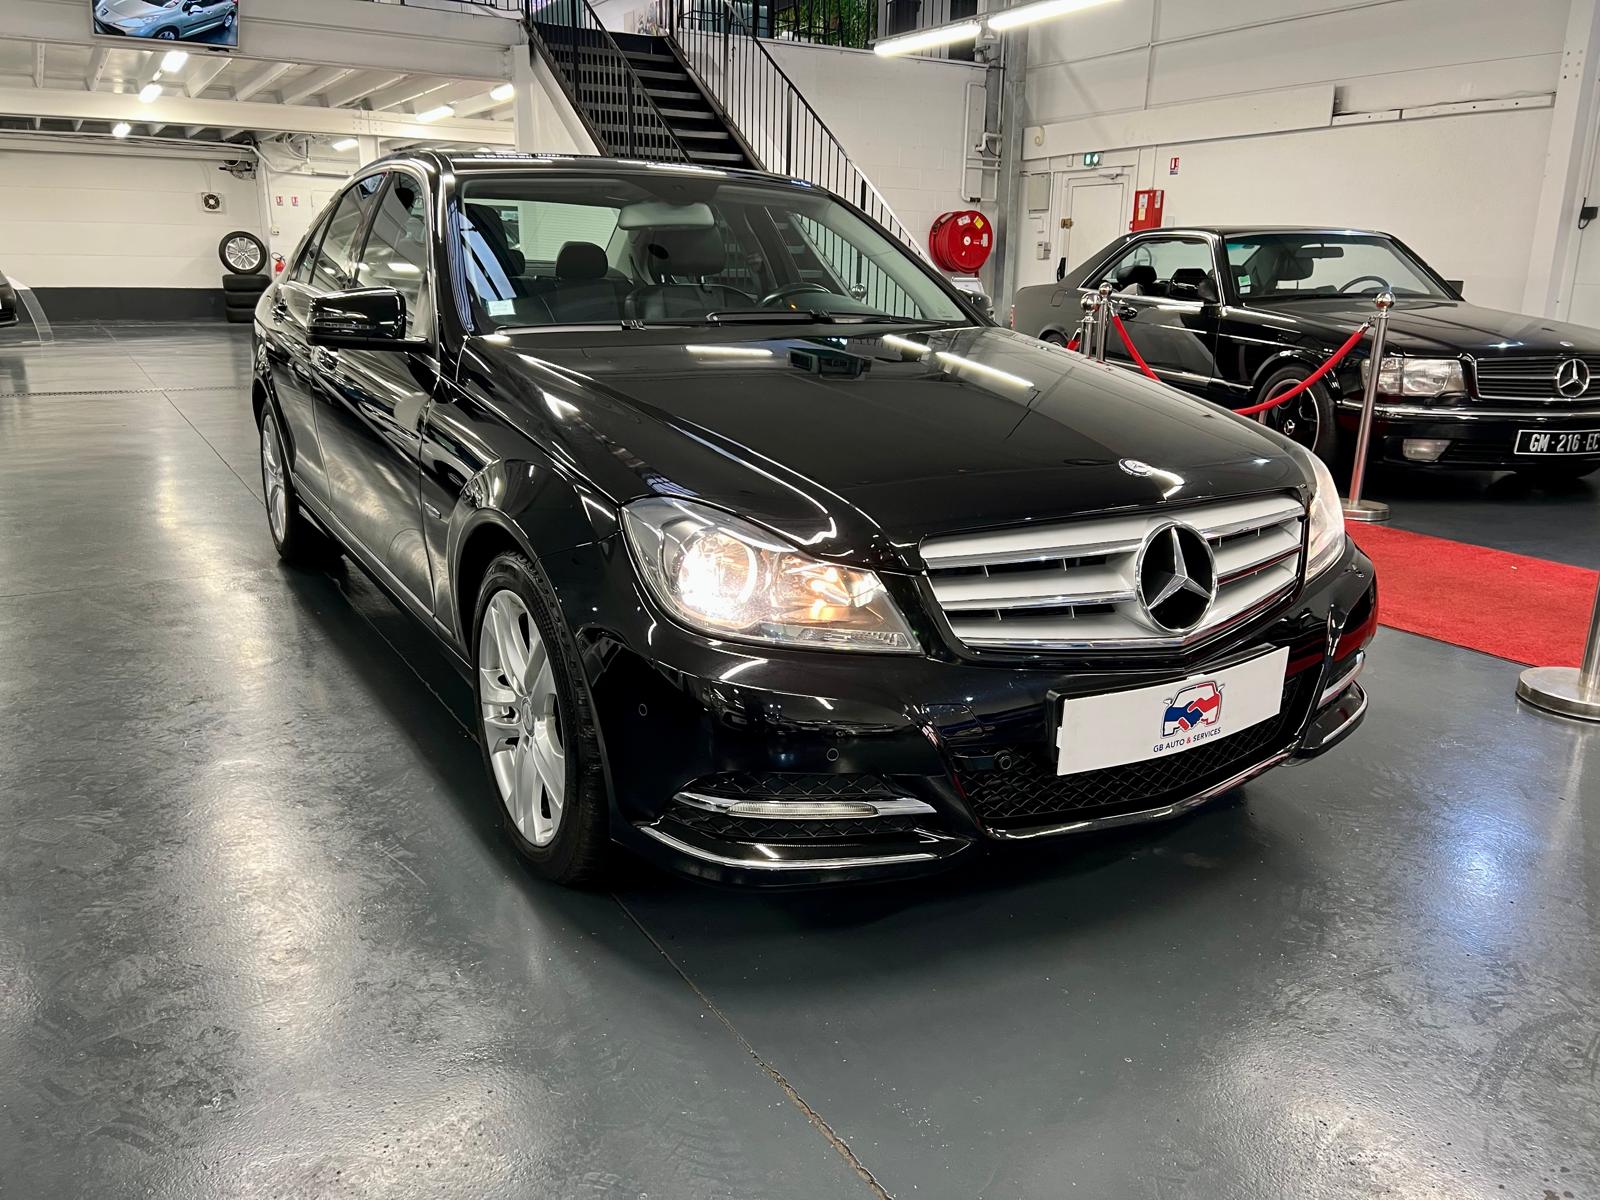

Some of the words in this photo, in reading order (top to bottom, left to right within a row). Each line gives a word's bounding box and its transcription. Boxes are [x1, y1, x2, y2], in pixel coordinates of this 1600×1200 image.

[1153, 744, 1164, 752] GB
[1165, 739, 1185, 749] AUTO
[1186, 736, 1192, 744] &
[1193, 727, 1221, 742] SERVICES
